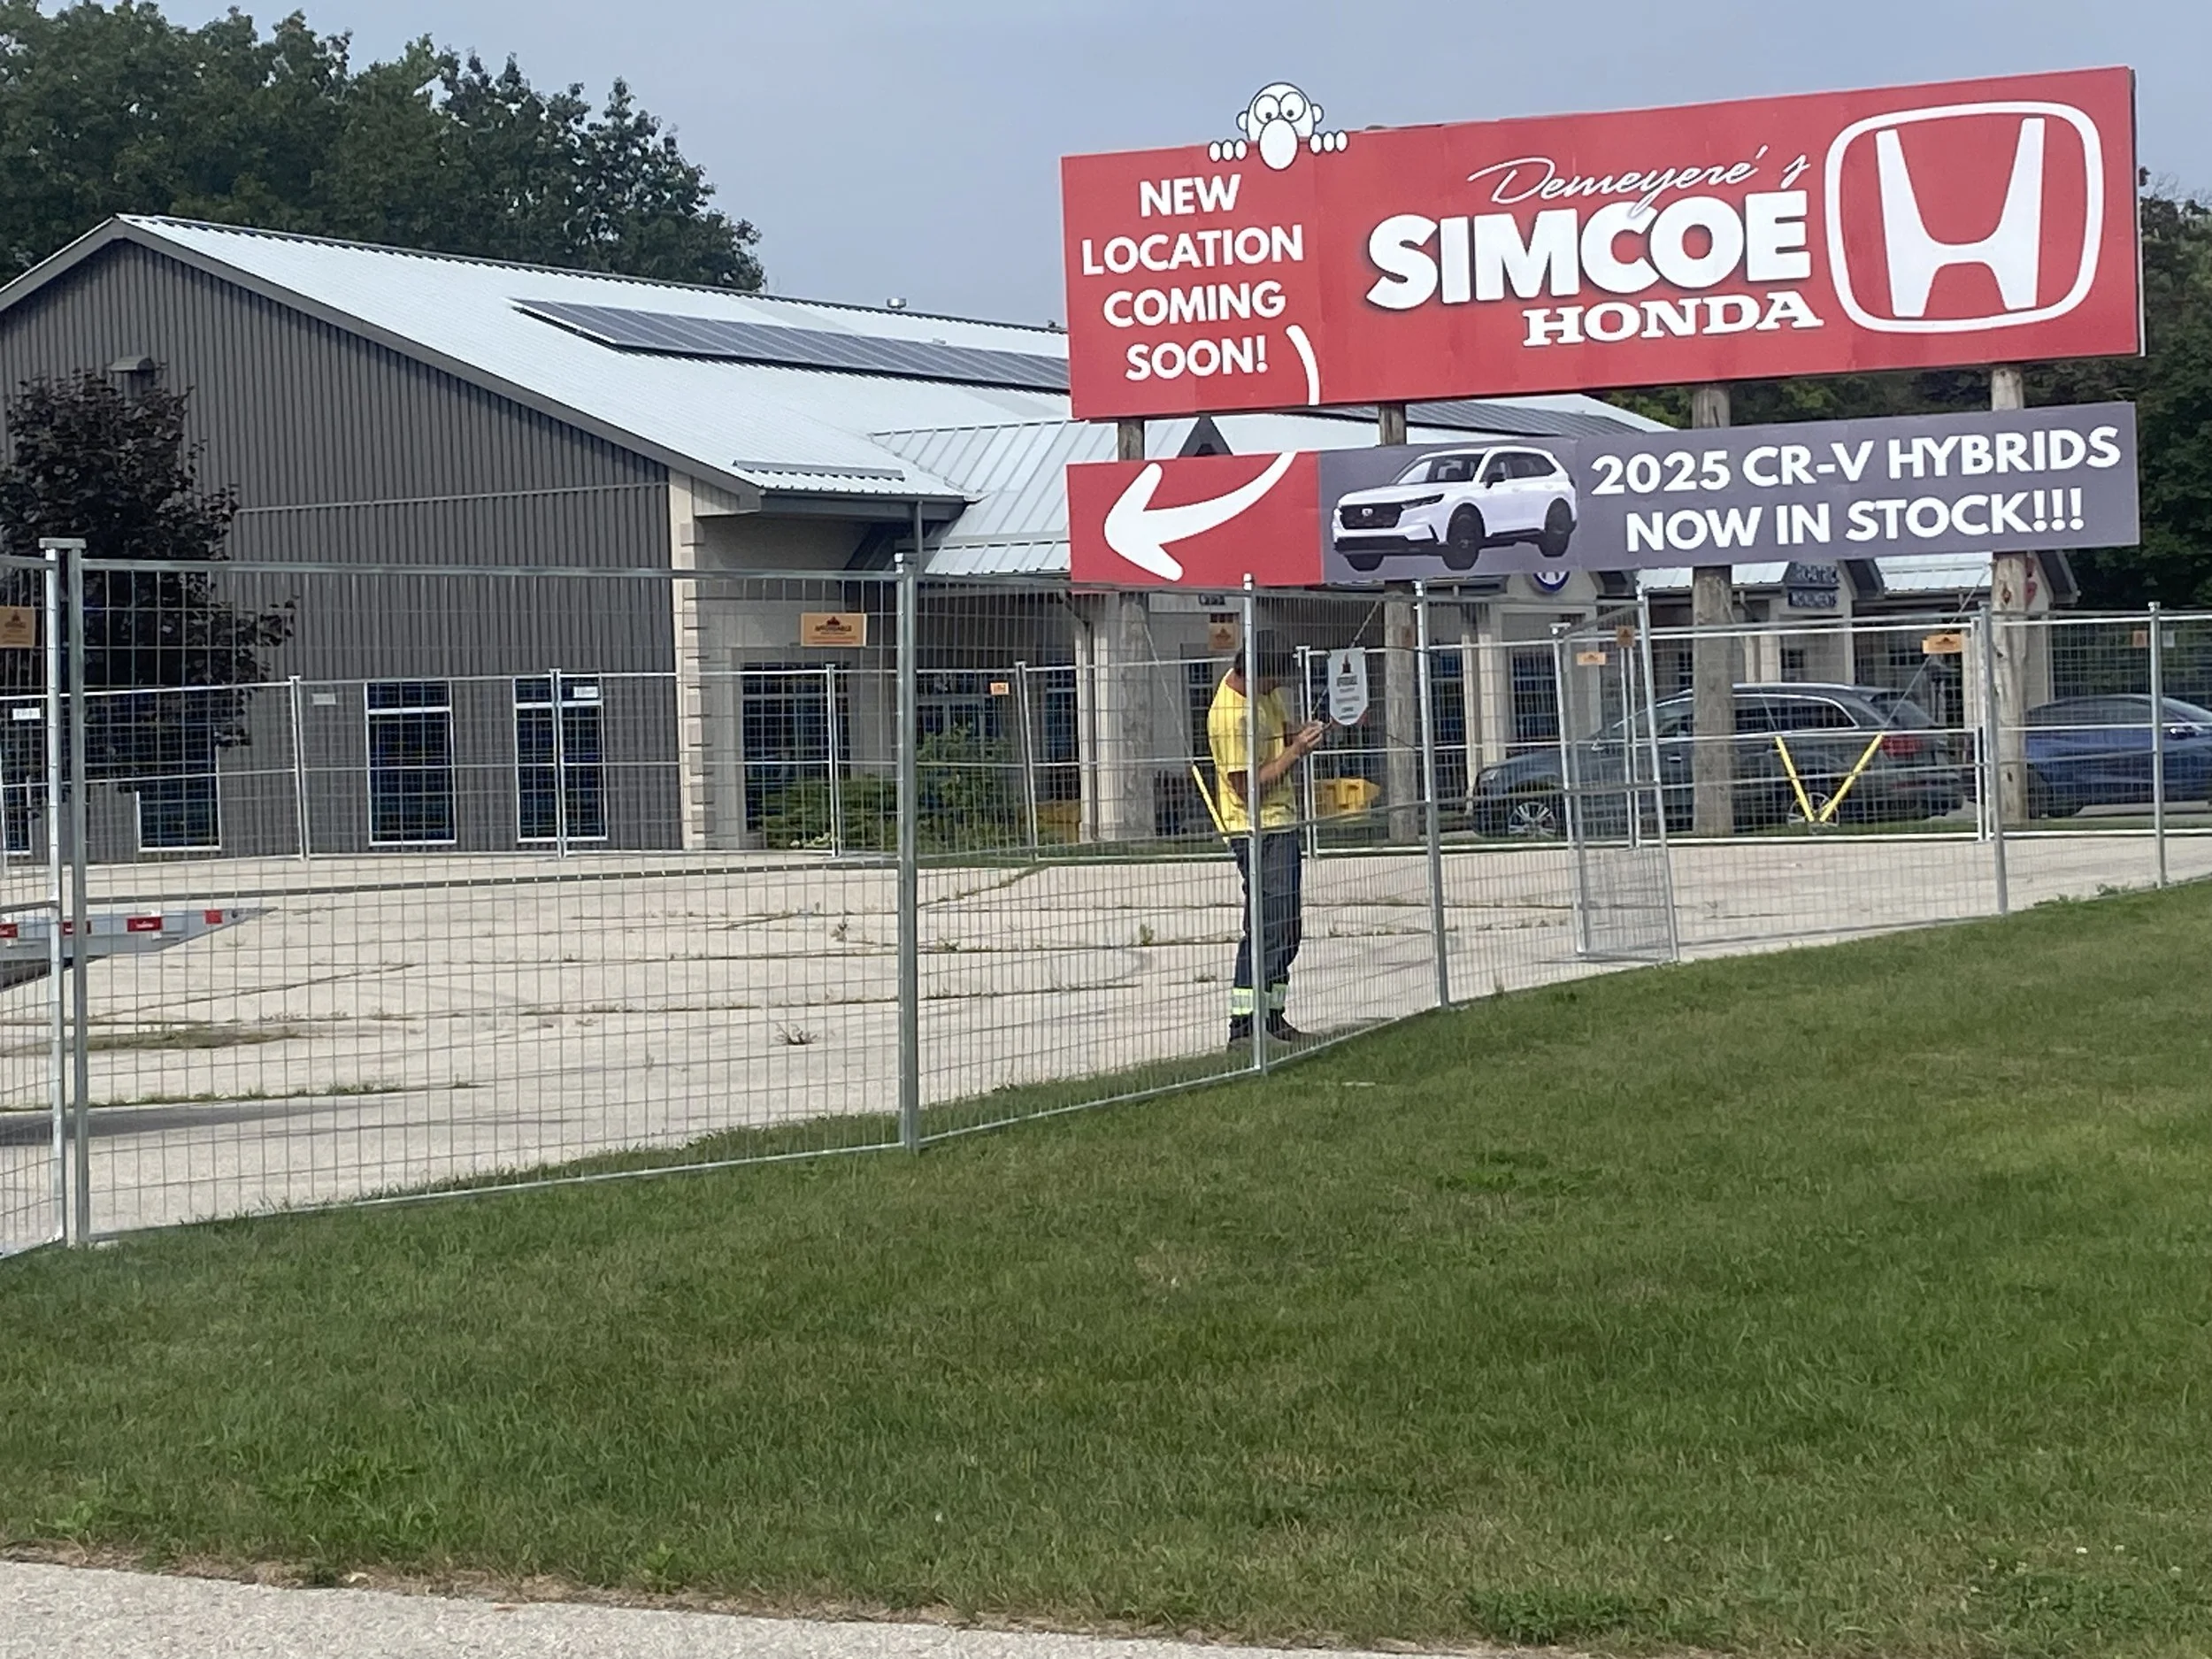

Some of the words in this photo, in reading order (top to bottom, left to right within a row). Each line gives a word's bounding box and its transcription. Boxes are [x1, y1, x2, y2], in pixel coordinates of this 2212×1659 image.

[1140, 173, 1240, 217] NEW
[1082, 224, 1303, 275] LOCATION
[1366, 189, 1811, 310] SIMCOE
[1103, 280, 1286, 327] COMING
[1522, 290, 1824, 347] HONDA
[1125, 334, 1268, 380] SOON!
[1591, 449, 1731, 495] 2025
[1742, 440, 1875, 488] CR-V
[1887, 426, 2121, 480] HYBRIDS
[1626, 506, 1763, 552] NOW
[1776, 503, 1831, 545] IN
[1845, 488, 2085, 541] STOCK!!!
